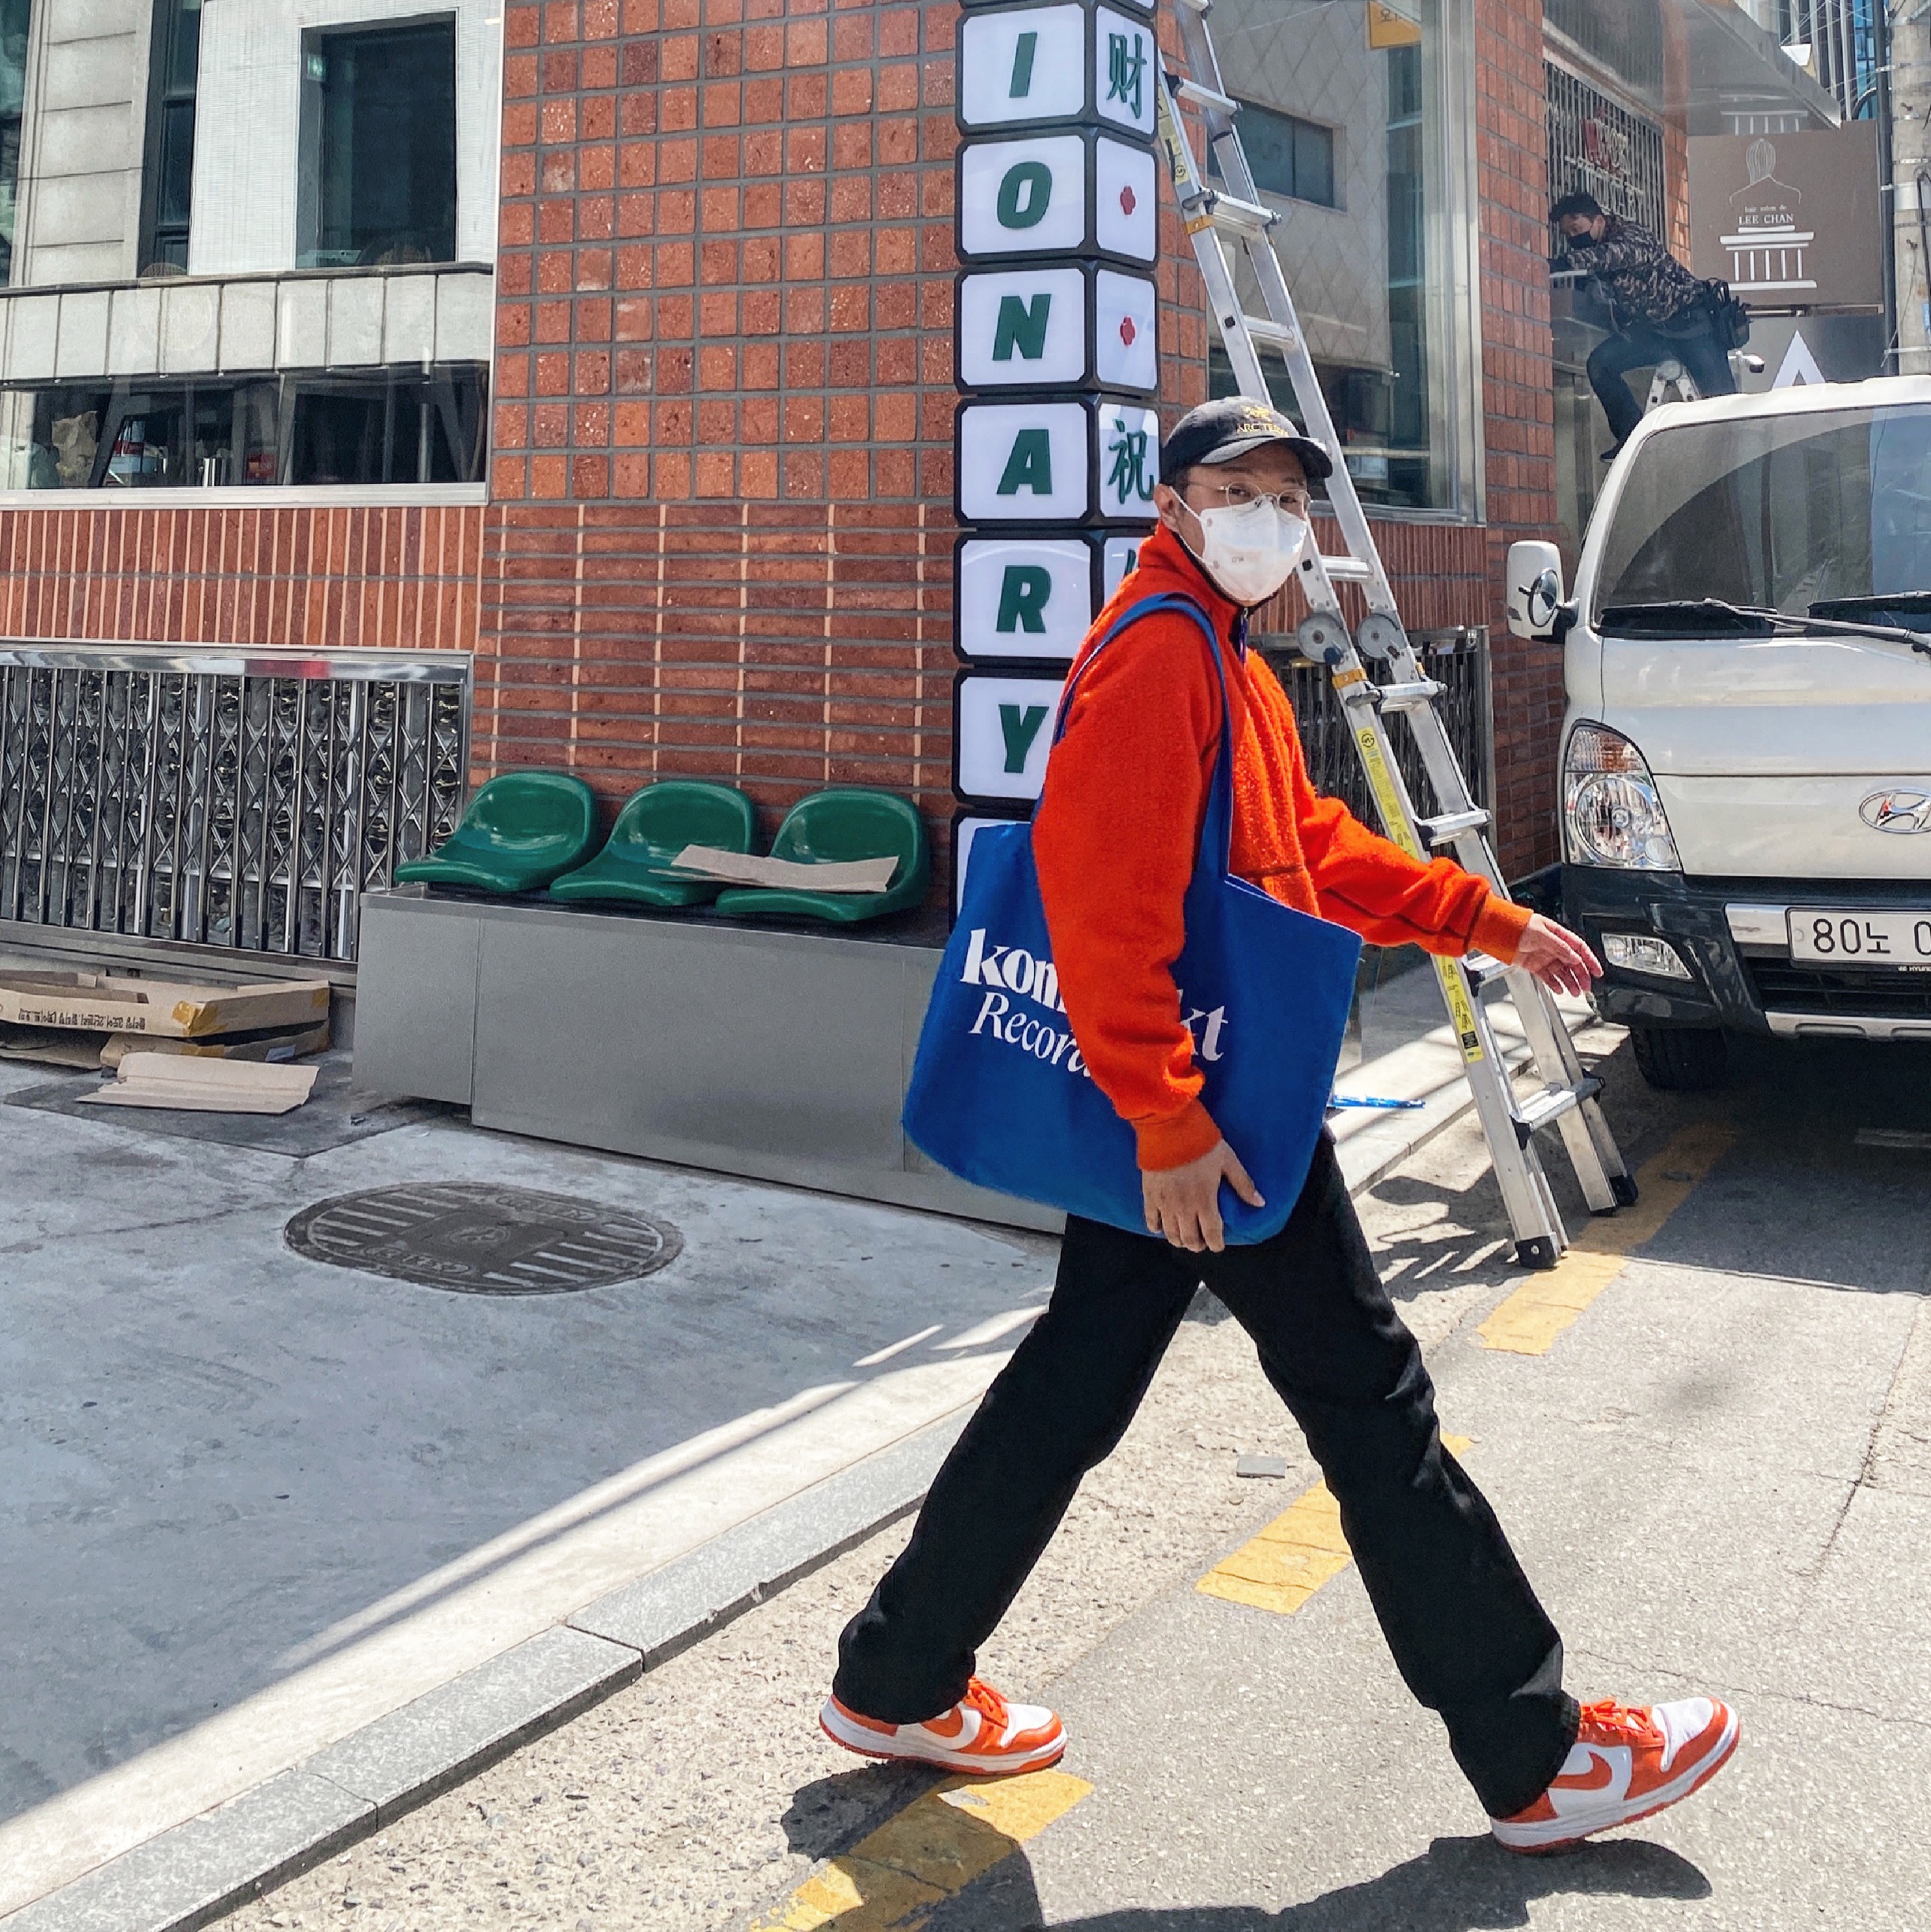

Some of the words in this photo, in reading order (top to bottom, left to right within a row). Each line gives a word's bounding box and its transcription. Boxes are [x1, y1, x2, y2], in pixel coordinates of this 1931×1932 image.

[1107, 32, 1148, 120] 财
[1738, 214, 1759, 225] LEE
[1764, 214, 1794, 224] CHAN
[1108, 418, 1154, 504] 祝
[1813, 918, 1891, 954] 80노
